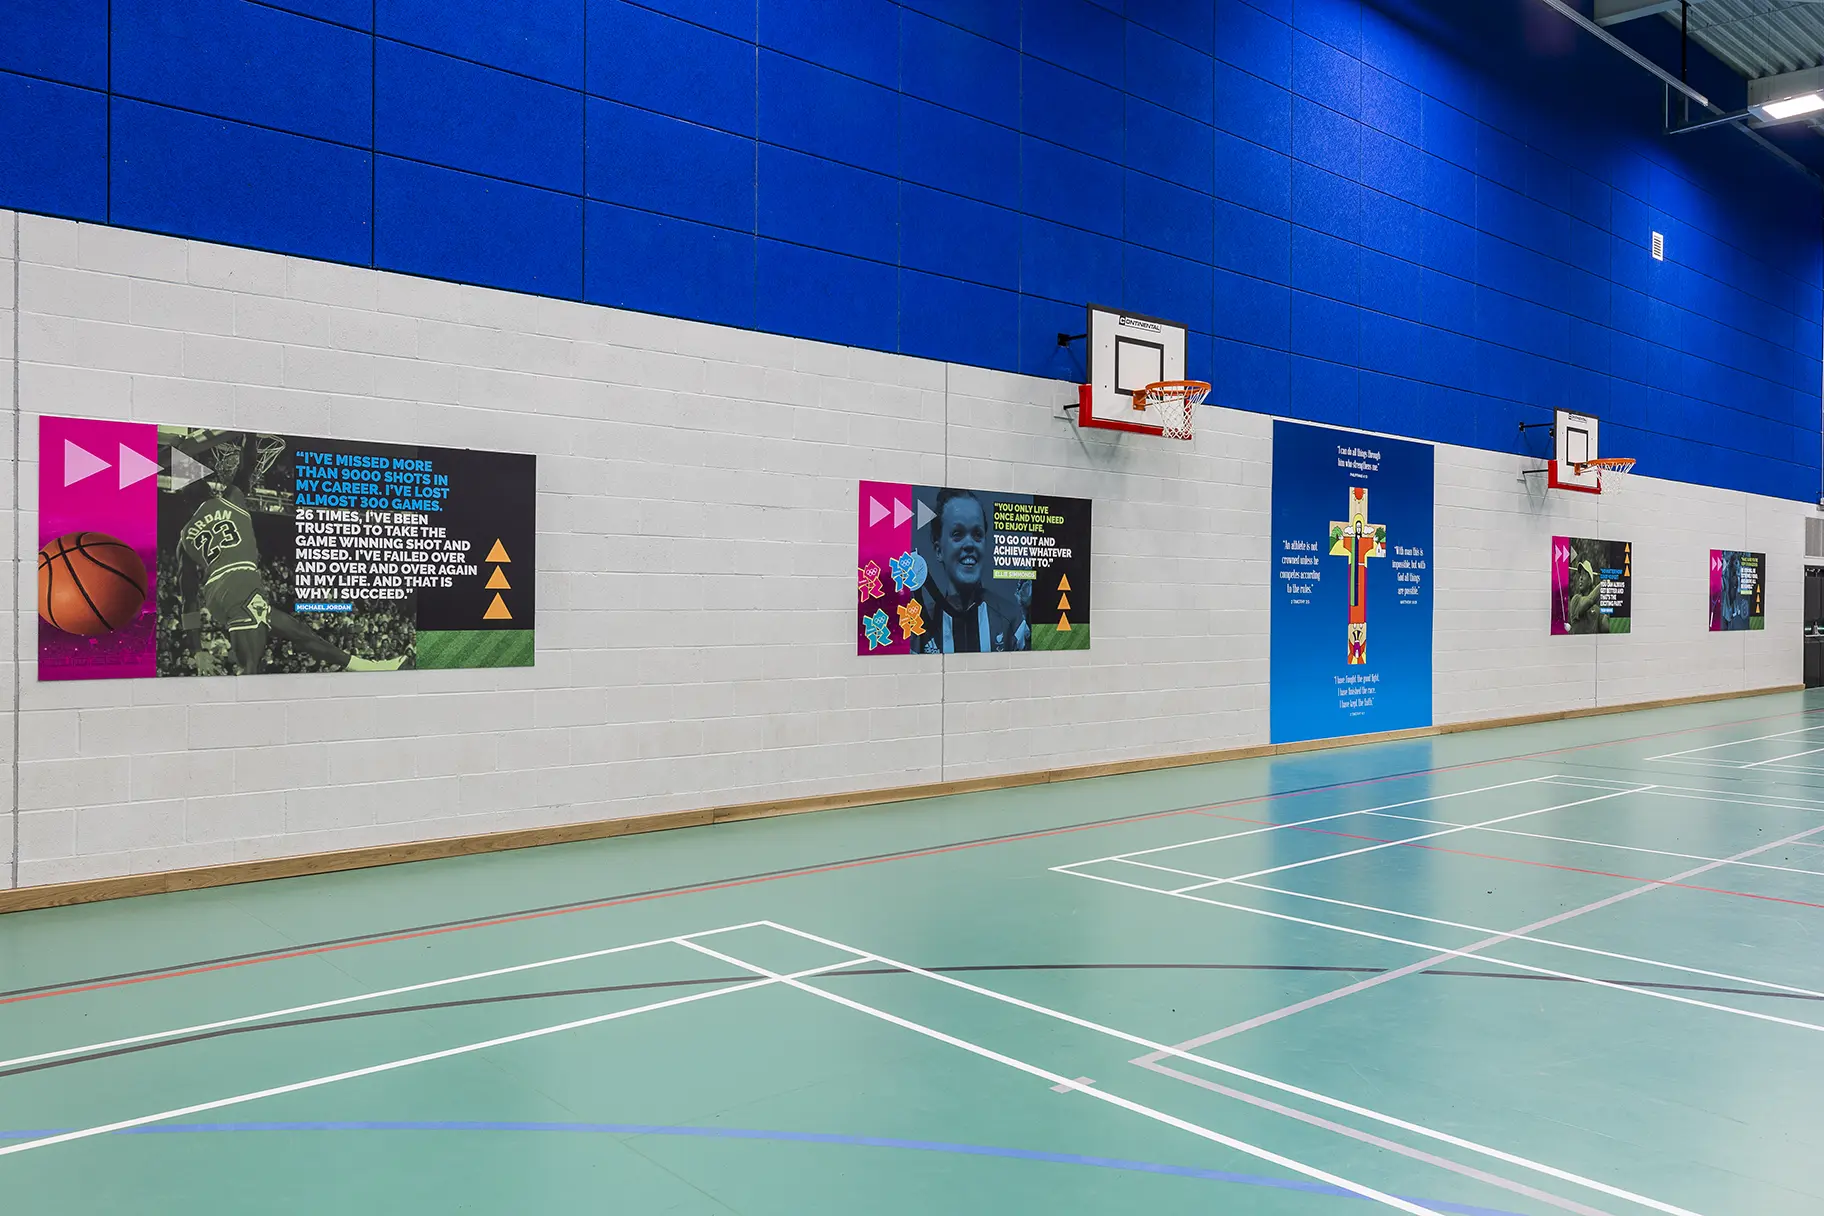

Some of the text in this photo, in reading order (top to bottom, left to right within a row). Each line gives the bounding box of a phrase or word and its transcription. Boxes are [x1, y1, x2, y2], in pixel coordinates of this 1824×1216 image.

[1119, 315, 1160, 332] CONTINENTAL
[296, 451, 433, 472] "I'VE MISSED MORE
[296, 466, 449, 486] THAN 9000 SHOTS IN
[296, 480, 450, 499] MY CAREER. I'VE LOST
[295, 494, 443, 511] ALMOST 300 GAMES.
[1014, 504, 1033, 513] ONLY
[1034, 505, 1049, 514] LIVE
[295, 509, 429, 525] 26 TIMES, I'VE BEEN
[994, 512, 1064, 524] ONCE AND YOU NEED
[186, 509, 232, 541] JORDAN
[295, 522, 446, 538] TRUSTED TO TAKE THE
[994, 521, 1004, 530] TO
[1005, 522, 1028, 531] ENJOY
[193, 519, 242, 566] 23
[295, 536, 471, 551] GAME WINNING SHOT AND
[993, 535, 1055, 546] TO GO OUT AND
[295, 549, 465, 563] MISSED. I'VE FAILED OVER
[993, 546, 1072, 558] ACHIEVE WHATEVER
[993, 556, 1011, 566] YOU
[1012, 557, 1036, 567] WANT
[295, 562, 478, 576] AND OVER AND OVER AGAIN
[295, 575, 453, 588] IN MY LIFE. AND THAT IS
[295, 587, 413, 600] WHY I SUCCEED."
[296, 603, 326, 611] MICHAEL
